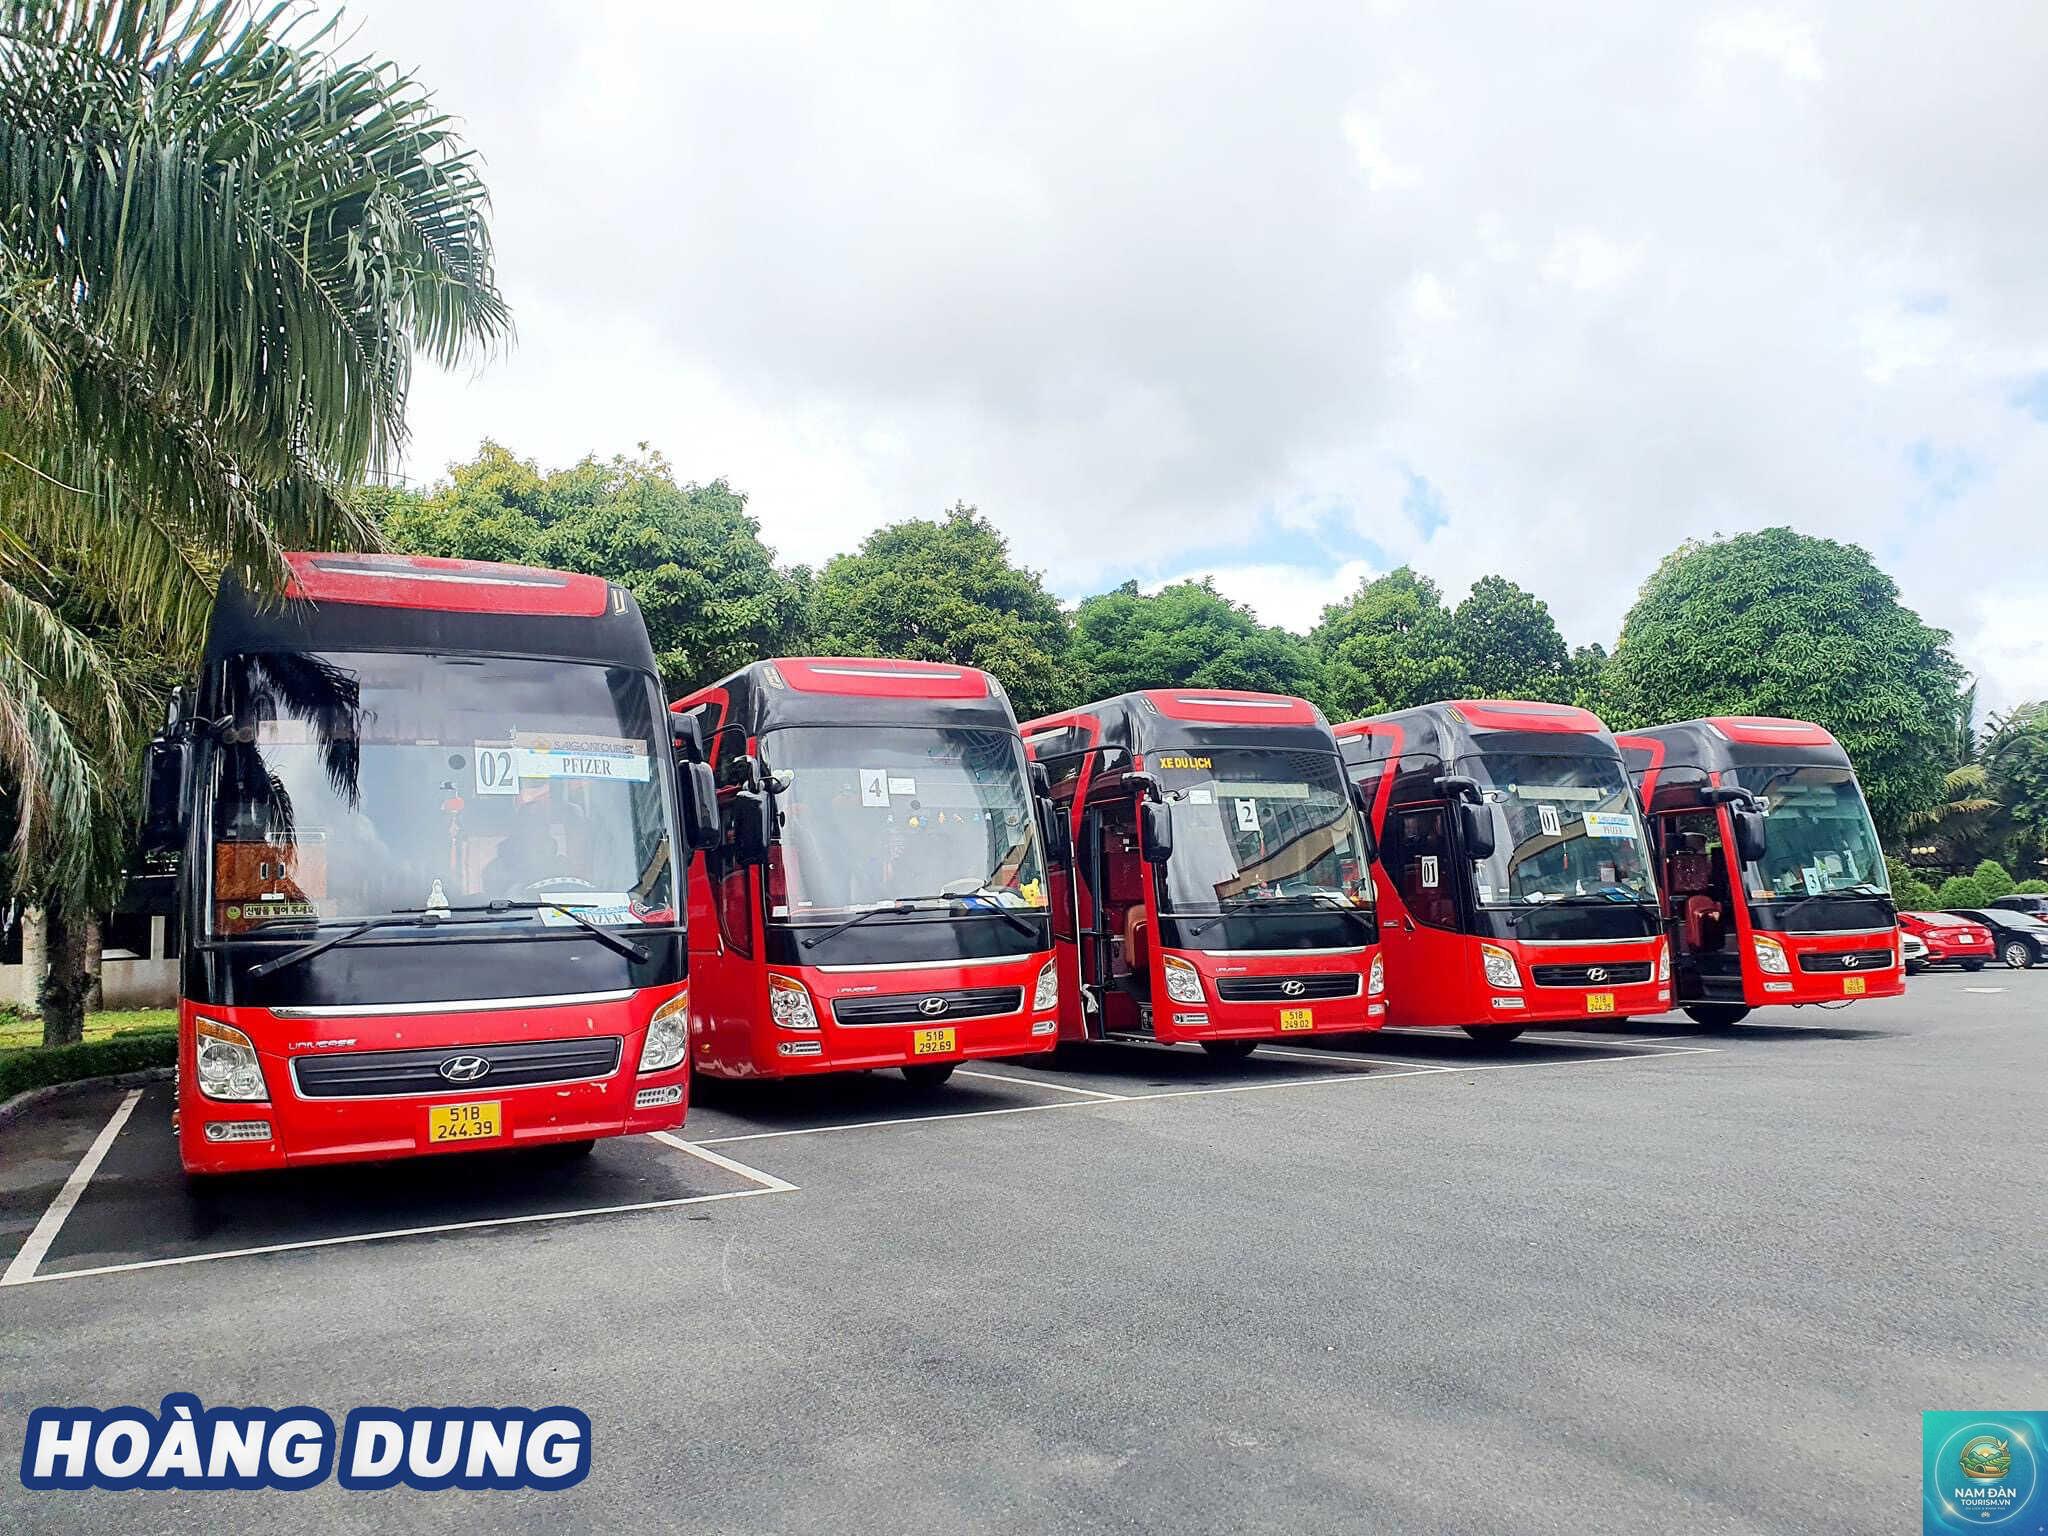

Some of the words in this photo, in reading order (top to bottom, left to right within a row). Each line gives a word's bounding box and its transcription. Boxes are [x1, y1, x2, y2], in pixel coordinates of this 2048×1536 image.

[480, 751, 513, 786] 02
[562, 757, 612, 775] PFIZER
[1160, 757, 1174, 769] XE
[1174, 757, 1188, 769] DU
[869, 777, 882, 798] 4
[1242, 805, 1254, 822] 2
[1542, 811, 1557, 832] 01
[1423, 862, 1436, 883] 01
[1288, 1011, 1304, 1020] 51B
[925, 1030, 945, 1041] 51B
[450, 1106, 480, 1122] 51B
[437, 1121, 493, 1139] 244.39
